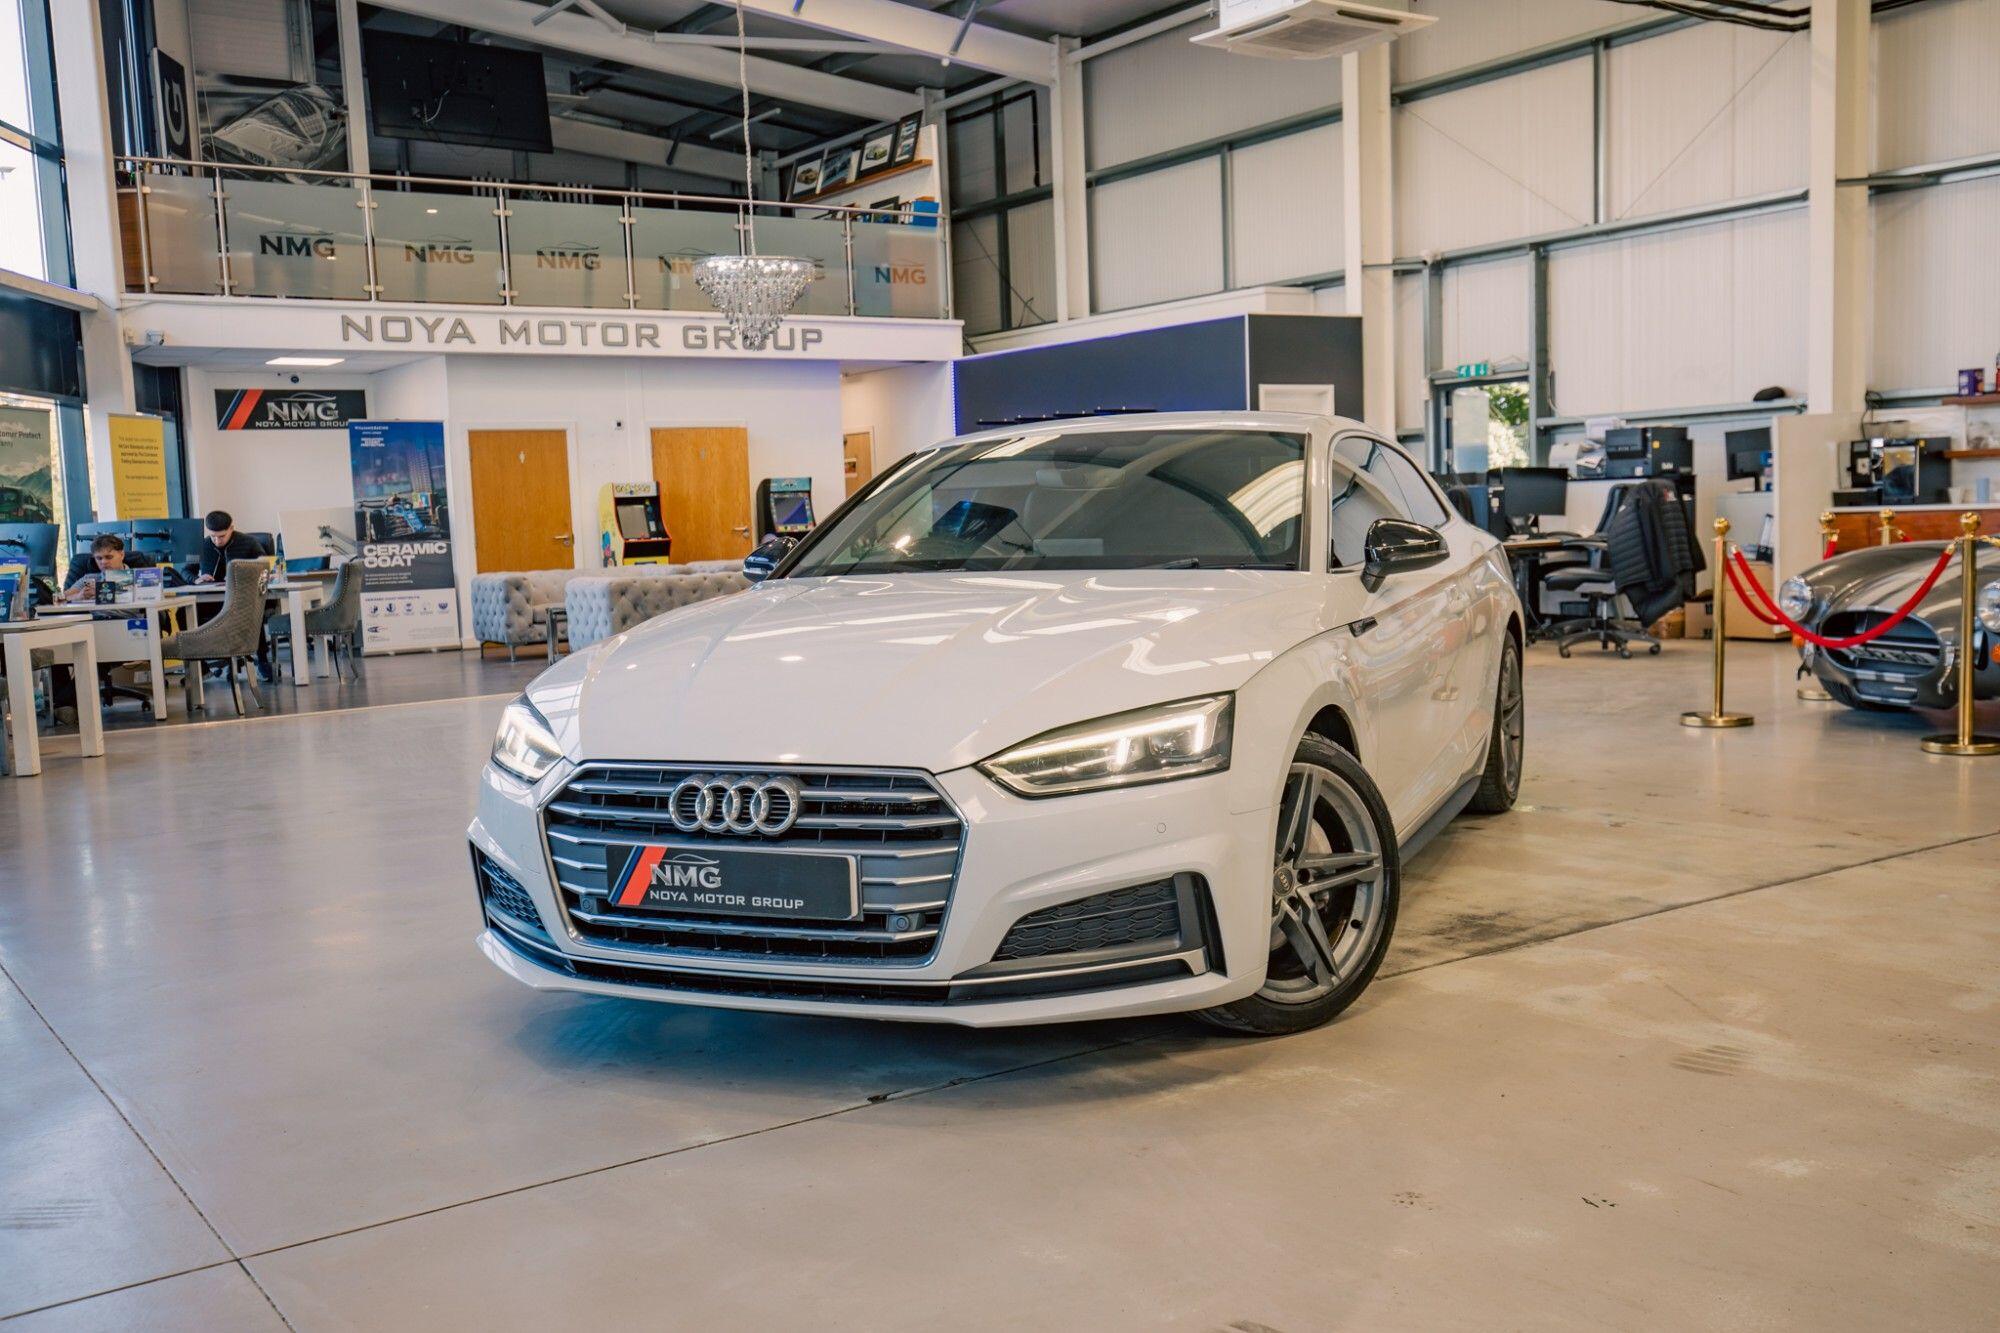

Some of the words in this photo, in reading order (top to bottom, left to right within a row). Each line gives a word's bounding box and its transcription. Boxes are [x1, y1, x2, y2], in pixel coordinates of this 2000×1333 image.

[259, 234, 336, 258] NMG
[404, 244, 475, 264] NMG
[536, 250, 601, 271] NMG
[658, 255, 694, 274] NM
[875, 266, 926, 285] NMG
[341, 315, 476, 344] NOYA
[499, 319, 661, 348] MOTOR
[266, 402, 339, 421] NMG
[255, 420, 280, 428] NOYA
[284, 420, 316, 428] MOTOR
[363, 542, 447, 557] CERAMIC
[363, 554, 412, 569] COAT
[650, 864, 722, 889] NMG
[650, 890, 689, 902] NOYA
[693, 892, 746, 906] MOTOR
[752, 896, 804, 909] GROUP
